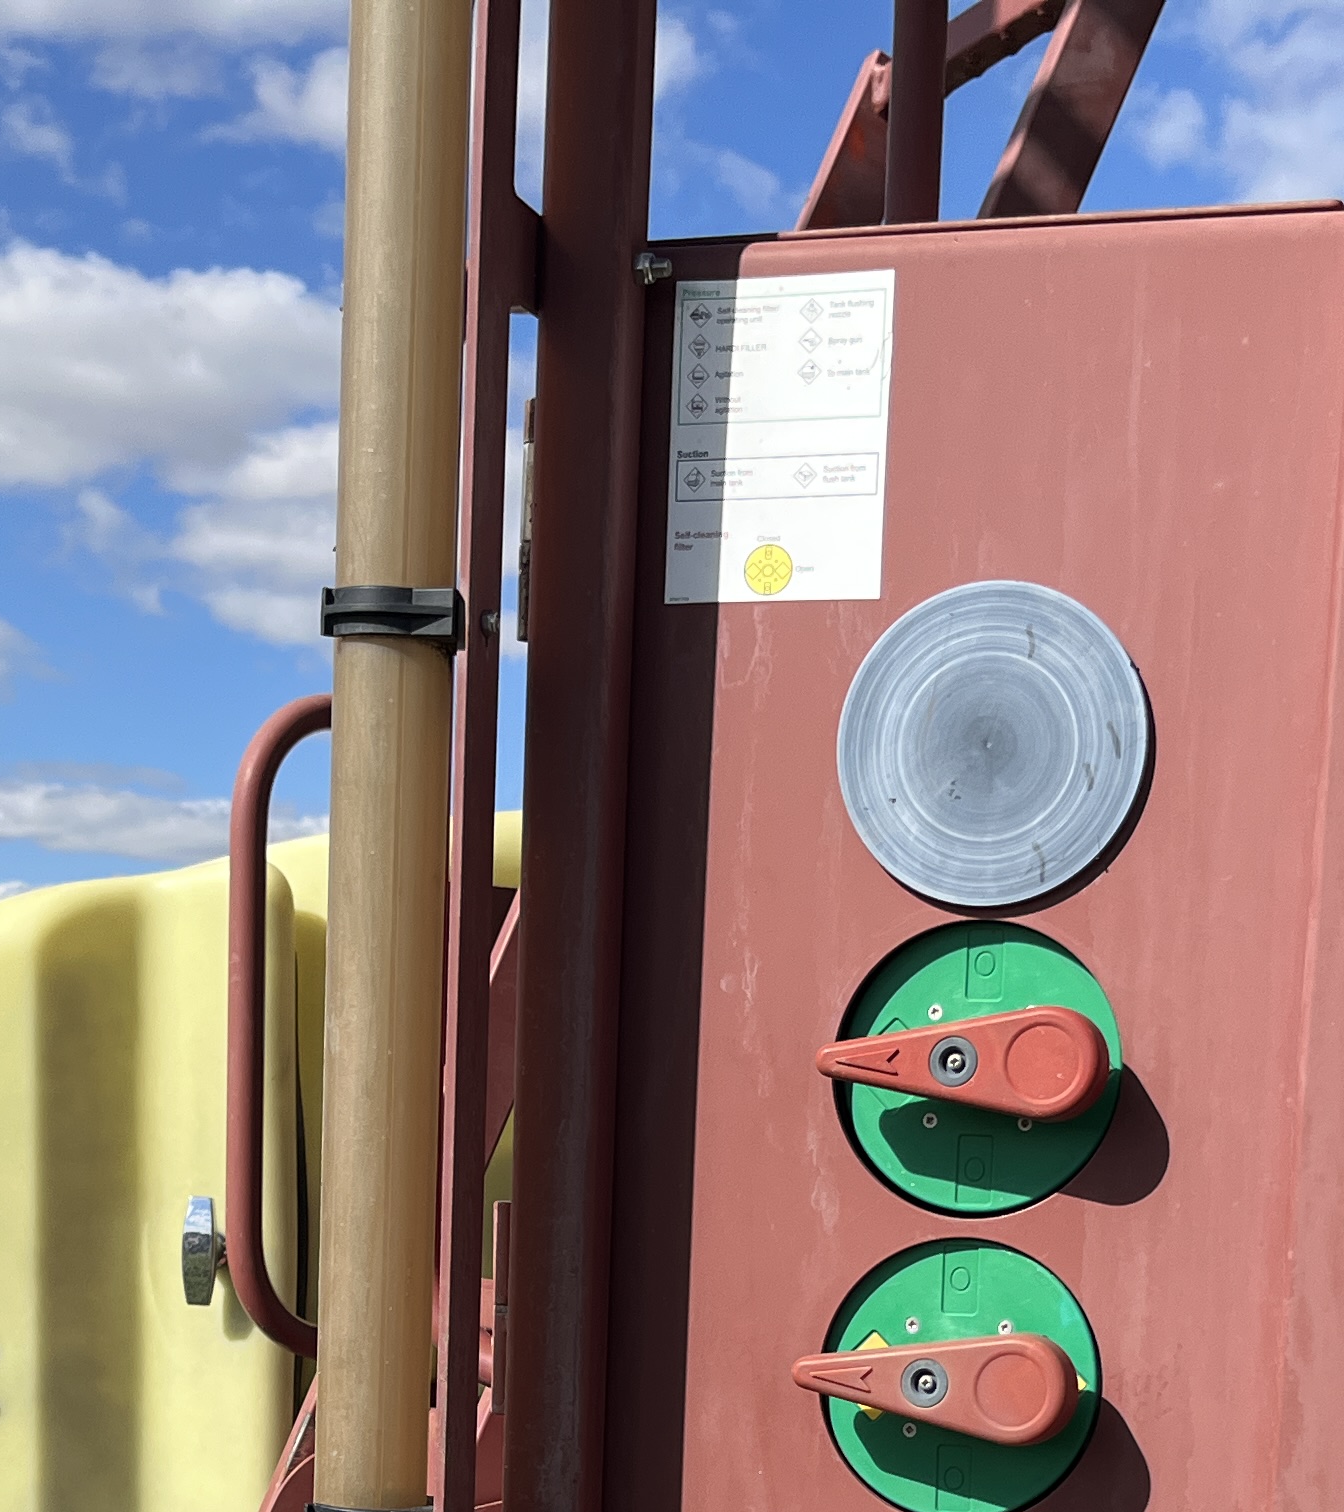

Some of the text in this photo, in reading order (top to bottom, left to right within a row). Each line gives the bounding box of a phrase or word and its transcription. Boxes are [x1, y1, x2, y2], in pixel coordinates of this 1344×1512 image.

[740, 343, 767, 352] FILLER
[676, 450, 709, 459] Suction
[674, 531, 729, 540] Self-cleaning
